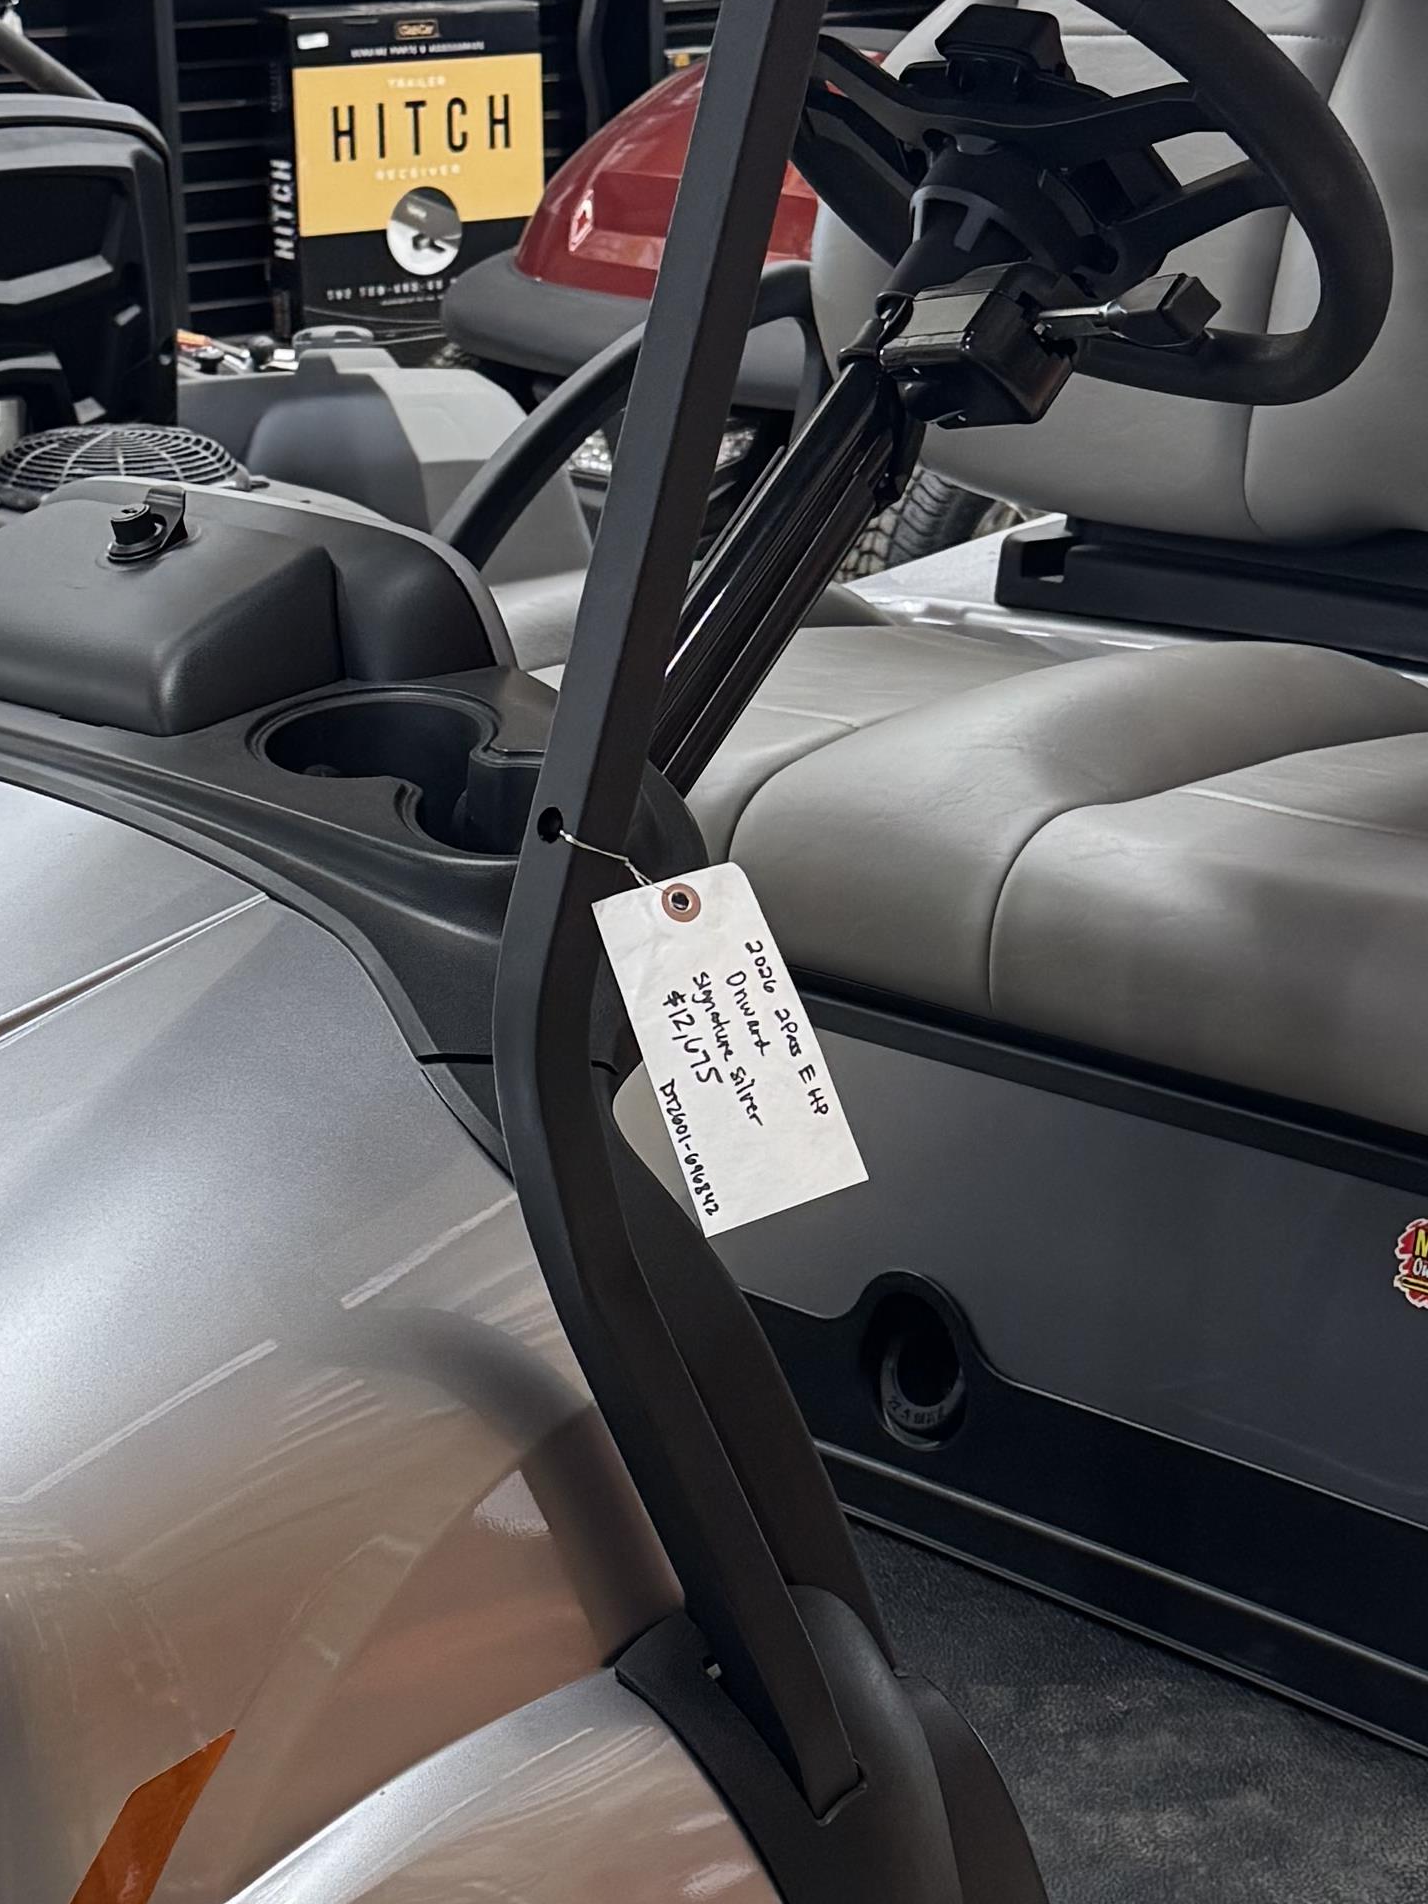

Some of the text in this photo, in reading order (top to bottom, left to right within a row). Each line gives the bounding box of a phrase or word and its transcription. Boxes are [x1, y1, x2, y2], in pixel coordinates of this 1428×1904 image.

[331, 93, 511, 163] HITCH
[375, 163, 462, 181] RECEIVER
[269, 158, 296, 261] HITCH
[662, 989, 725, 1084] $12,675
[725, 969, 772, 1057] Onward
[744, 939, 778, 994] 2026
[797, 1063, 817, 1085] E
[807, 1087, 830, 1116] HP
